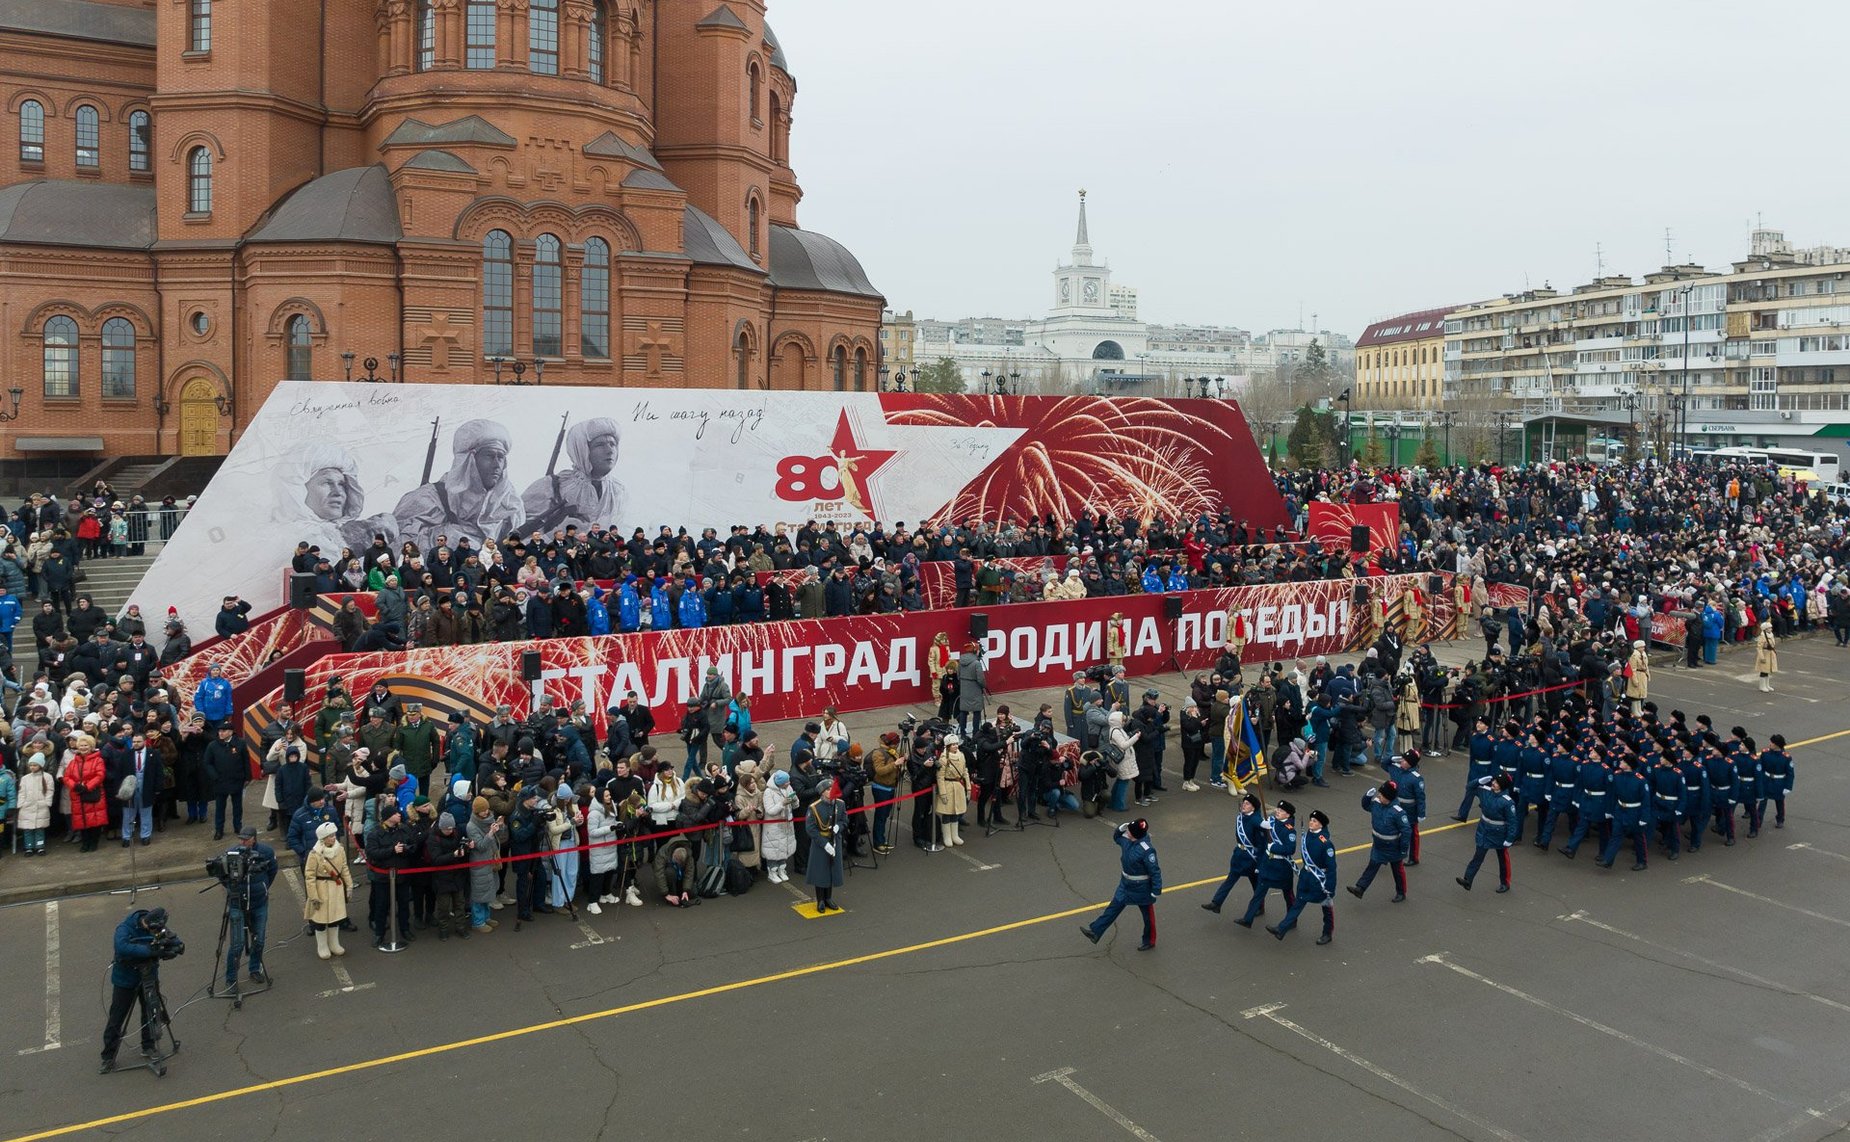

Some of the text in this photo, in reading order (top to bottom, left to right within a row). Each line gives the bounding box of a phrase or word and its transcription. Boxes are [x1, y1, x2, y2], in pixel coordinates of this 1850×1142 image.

[632, 400, 659, 421] Ни
[670, 410, 710, 440] шагу
[775, 455, 846, 501] 80
[813, 502, 844, 512] лет
